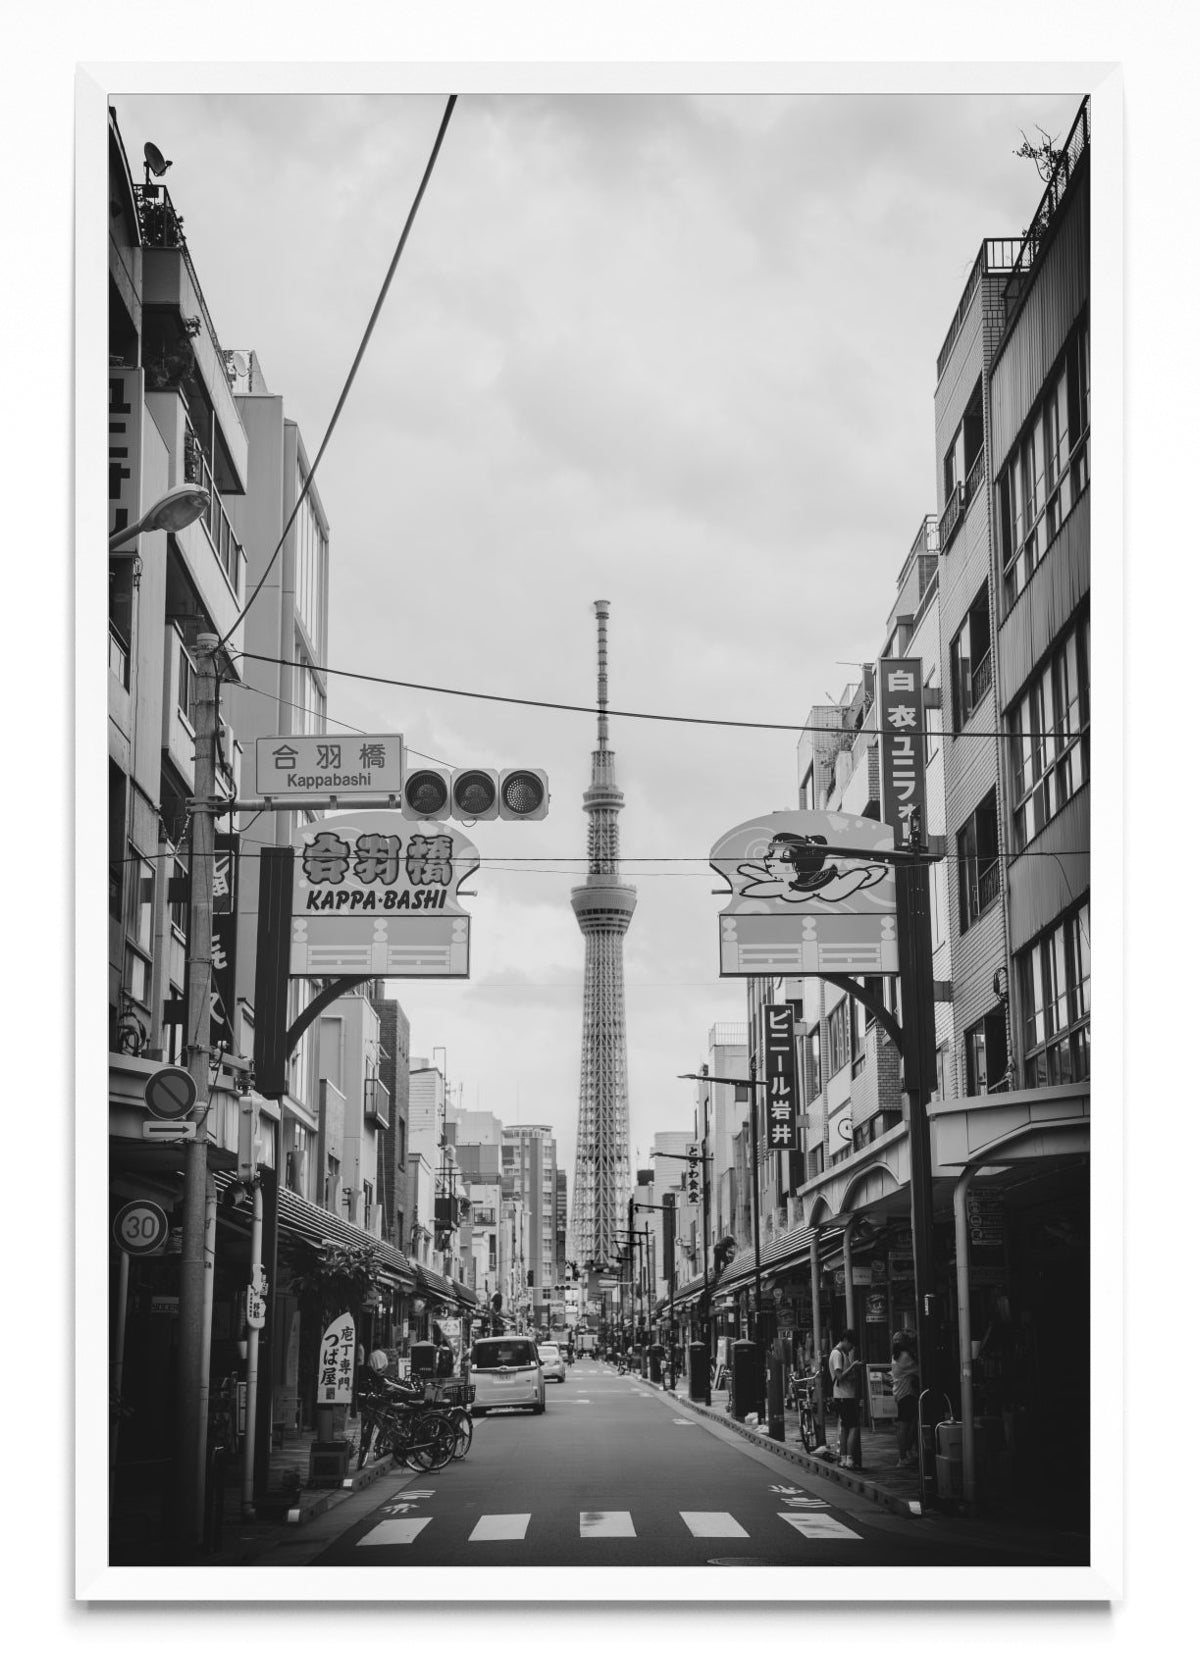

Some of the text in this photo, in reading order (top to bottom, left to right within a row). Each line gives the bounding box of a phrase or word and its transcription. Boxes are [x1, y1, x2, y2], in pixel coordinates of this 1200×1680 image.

[272, 744, 386, 769] 合羽橋
[287, 773, 371, 790] Kappabashi
[303, 832, 454, 886] 合羽橋
[769, 1009, 792, 1144] ビニール岩井
[126, 1217, 155, 1238] 30
[320, 1334, 340, 1386] つば屋
